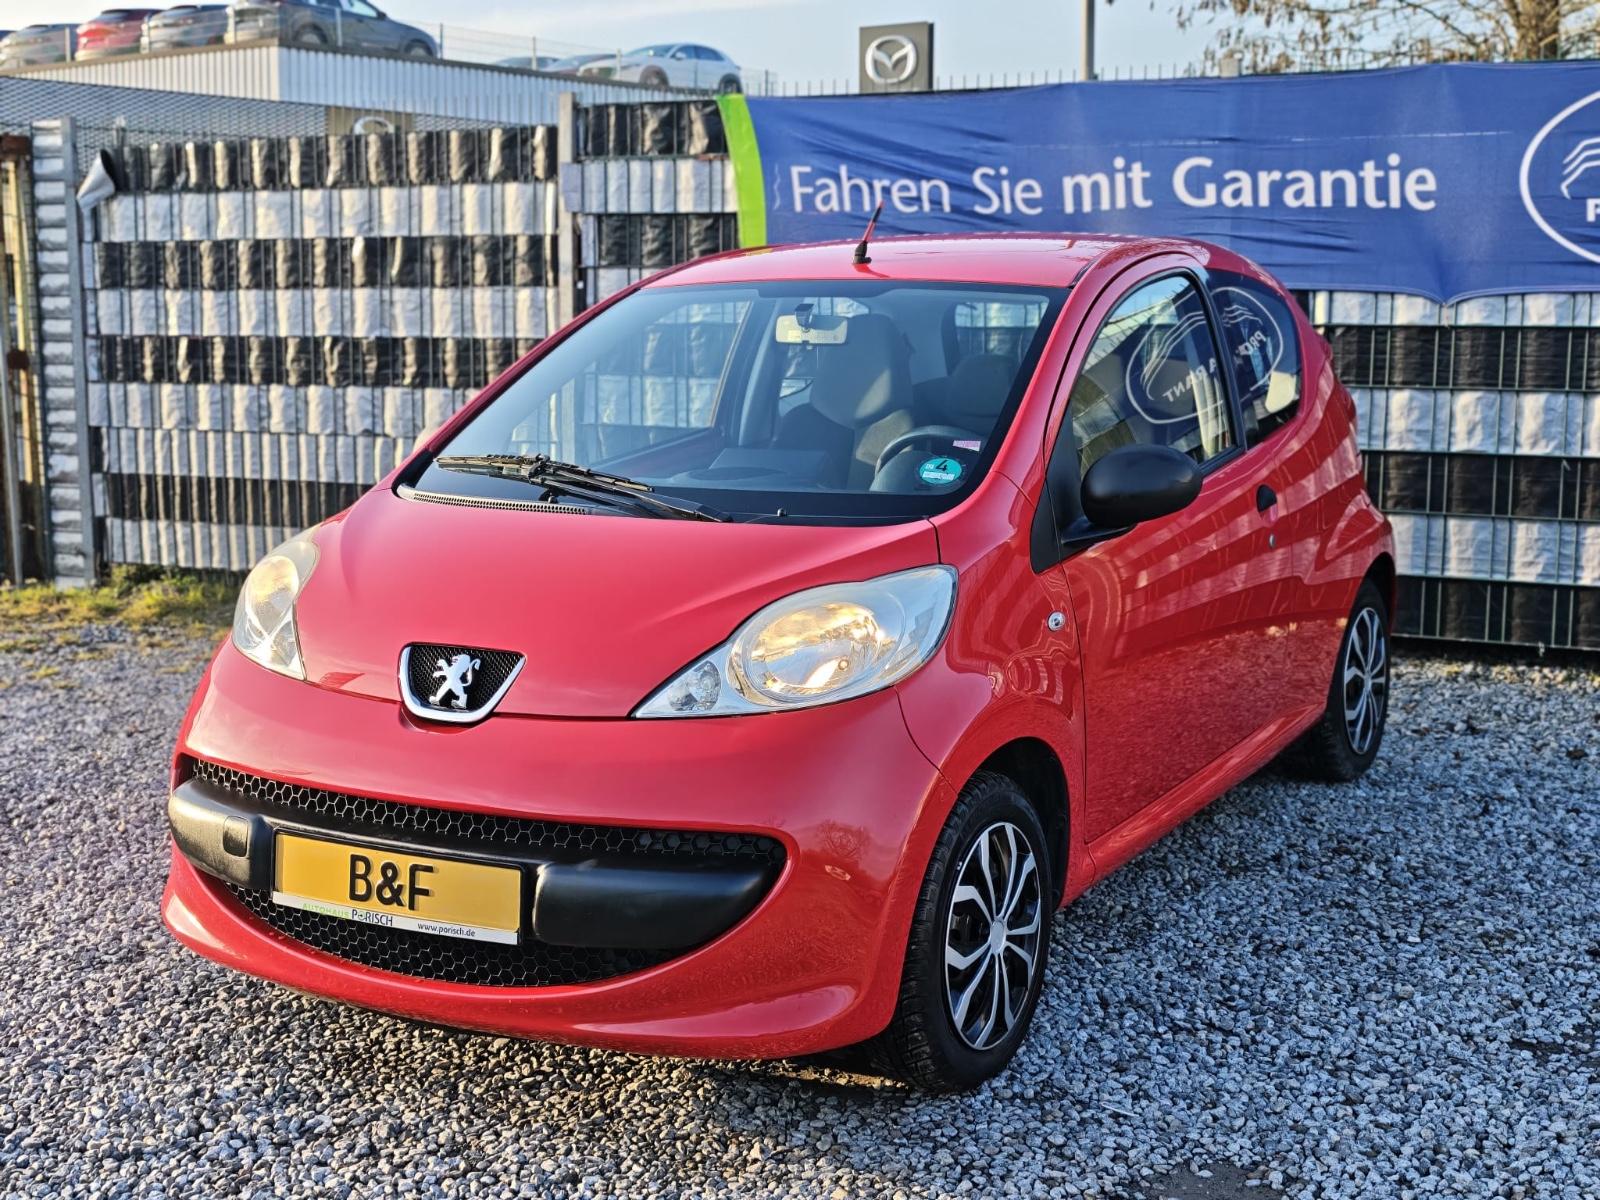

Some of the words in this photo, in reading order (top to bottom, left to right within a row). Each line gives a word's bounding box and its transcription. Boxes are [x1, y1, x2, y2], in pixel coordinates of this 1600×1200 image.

[790, 164, 951, 214] Fahren
[973, 166, 1043, 215] Sie
[1063, 157, 1151, 215] mit
[1172, 153, 1437, 211] Garantie
[348, 853, 435, 910] B&F
[302, 903, 349, 919] AUTOHAUS
[417, 922, 476, 937] www.porisch.de
